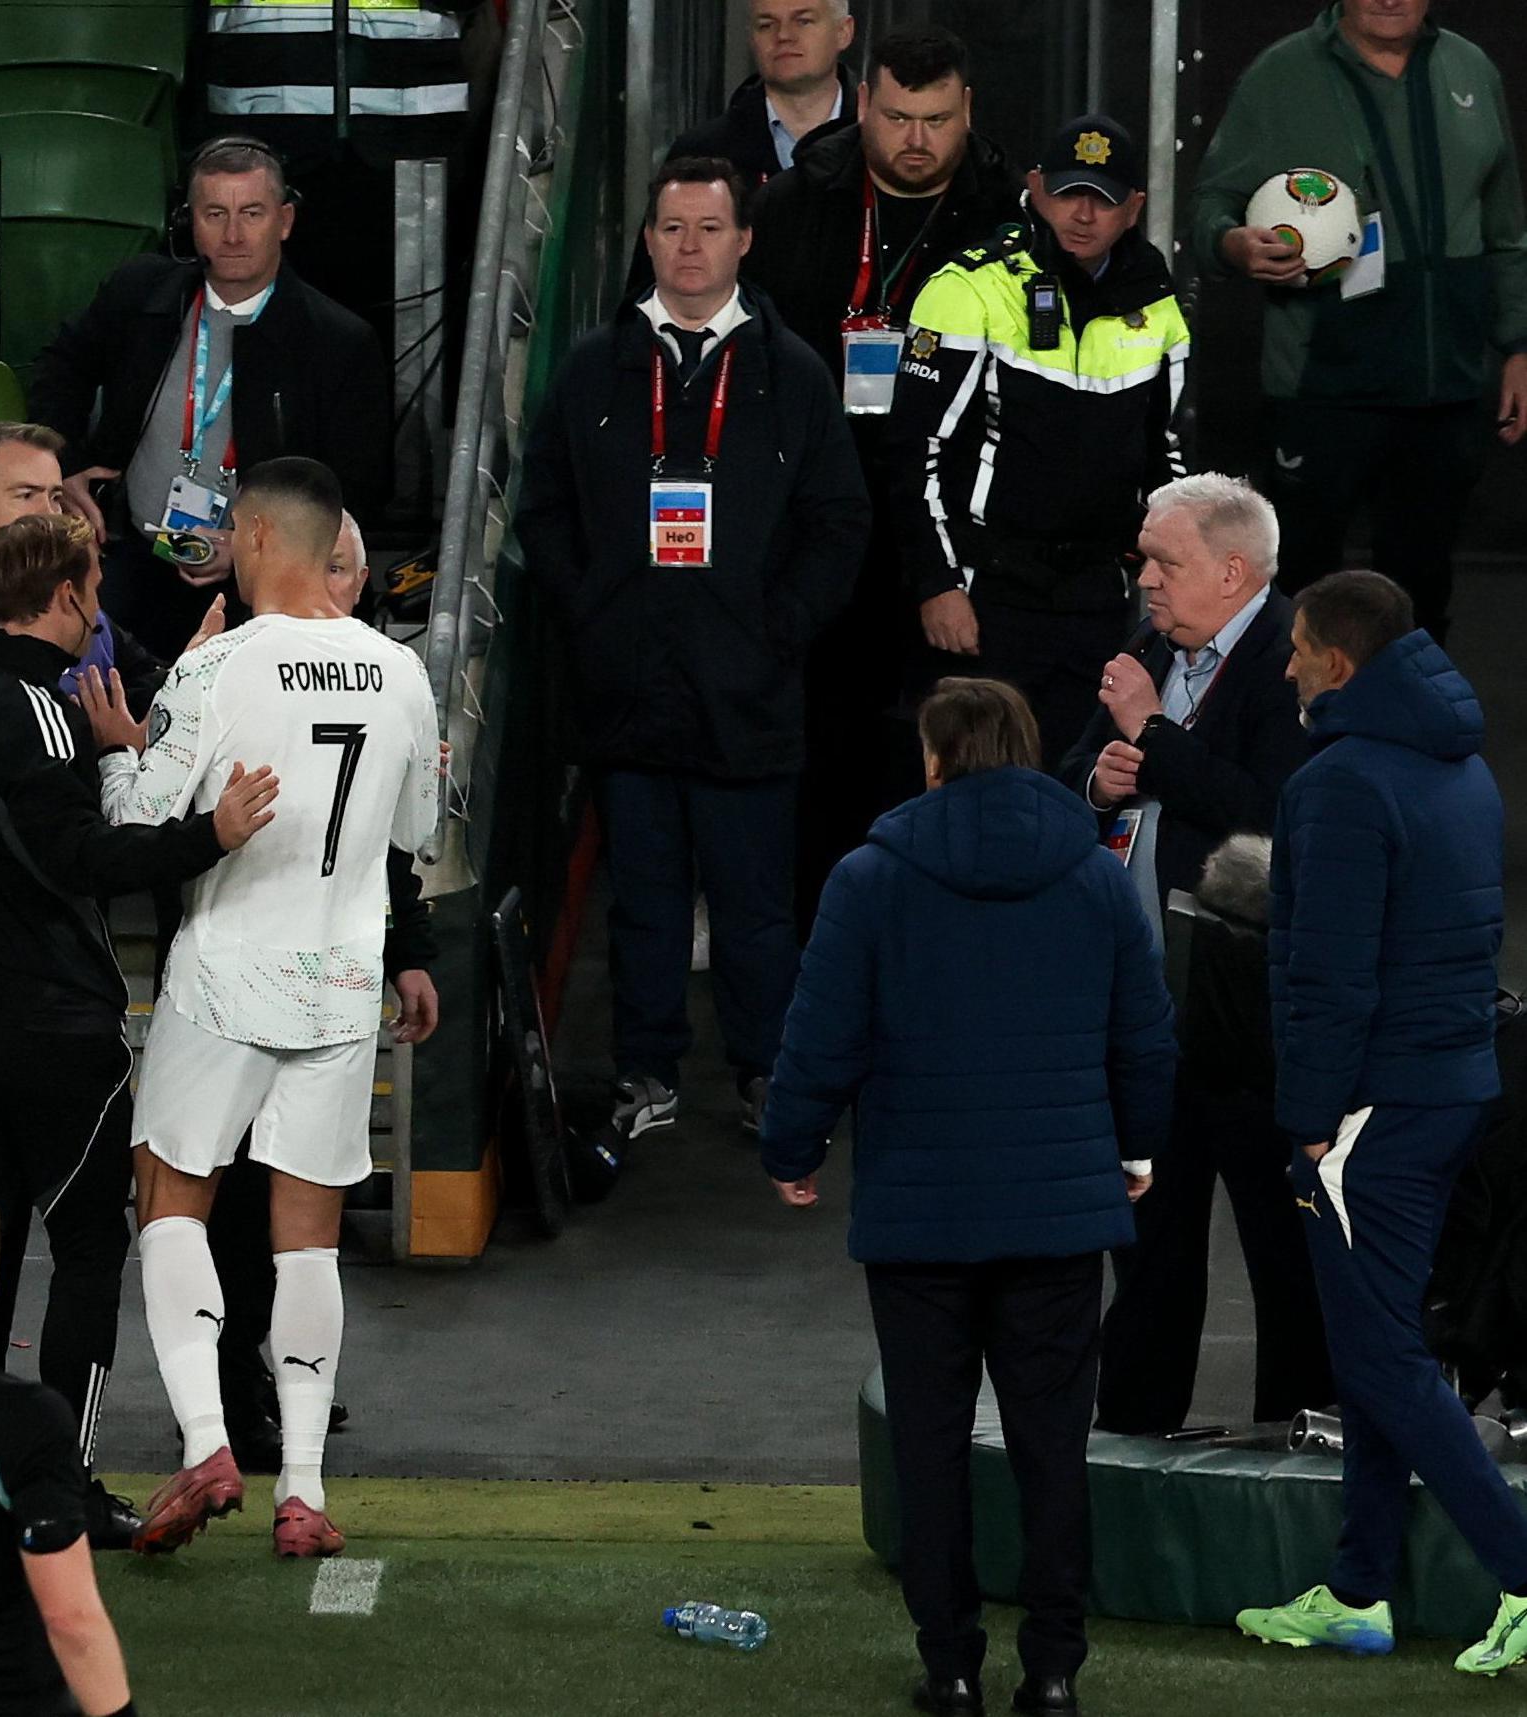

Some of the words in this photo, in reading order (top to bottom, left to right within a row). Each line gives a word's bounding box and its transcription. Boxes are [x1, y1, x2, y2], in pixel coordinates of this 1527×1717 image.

[899, 361, 941, 383] ARDA
[665, 531, 696, 544] HeO
[277, 661, 384, 693] RONALDO
[311, 723, 368, 878] 7
